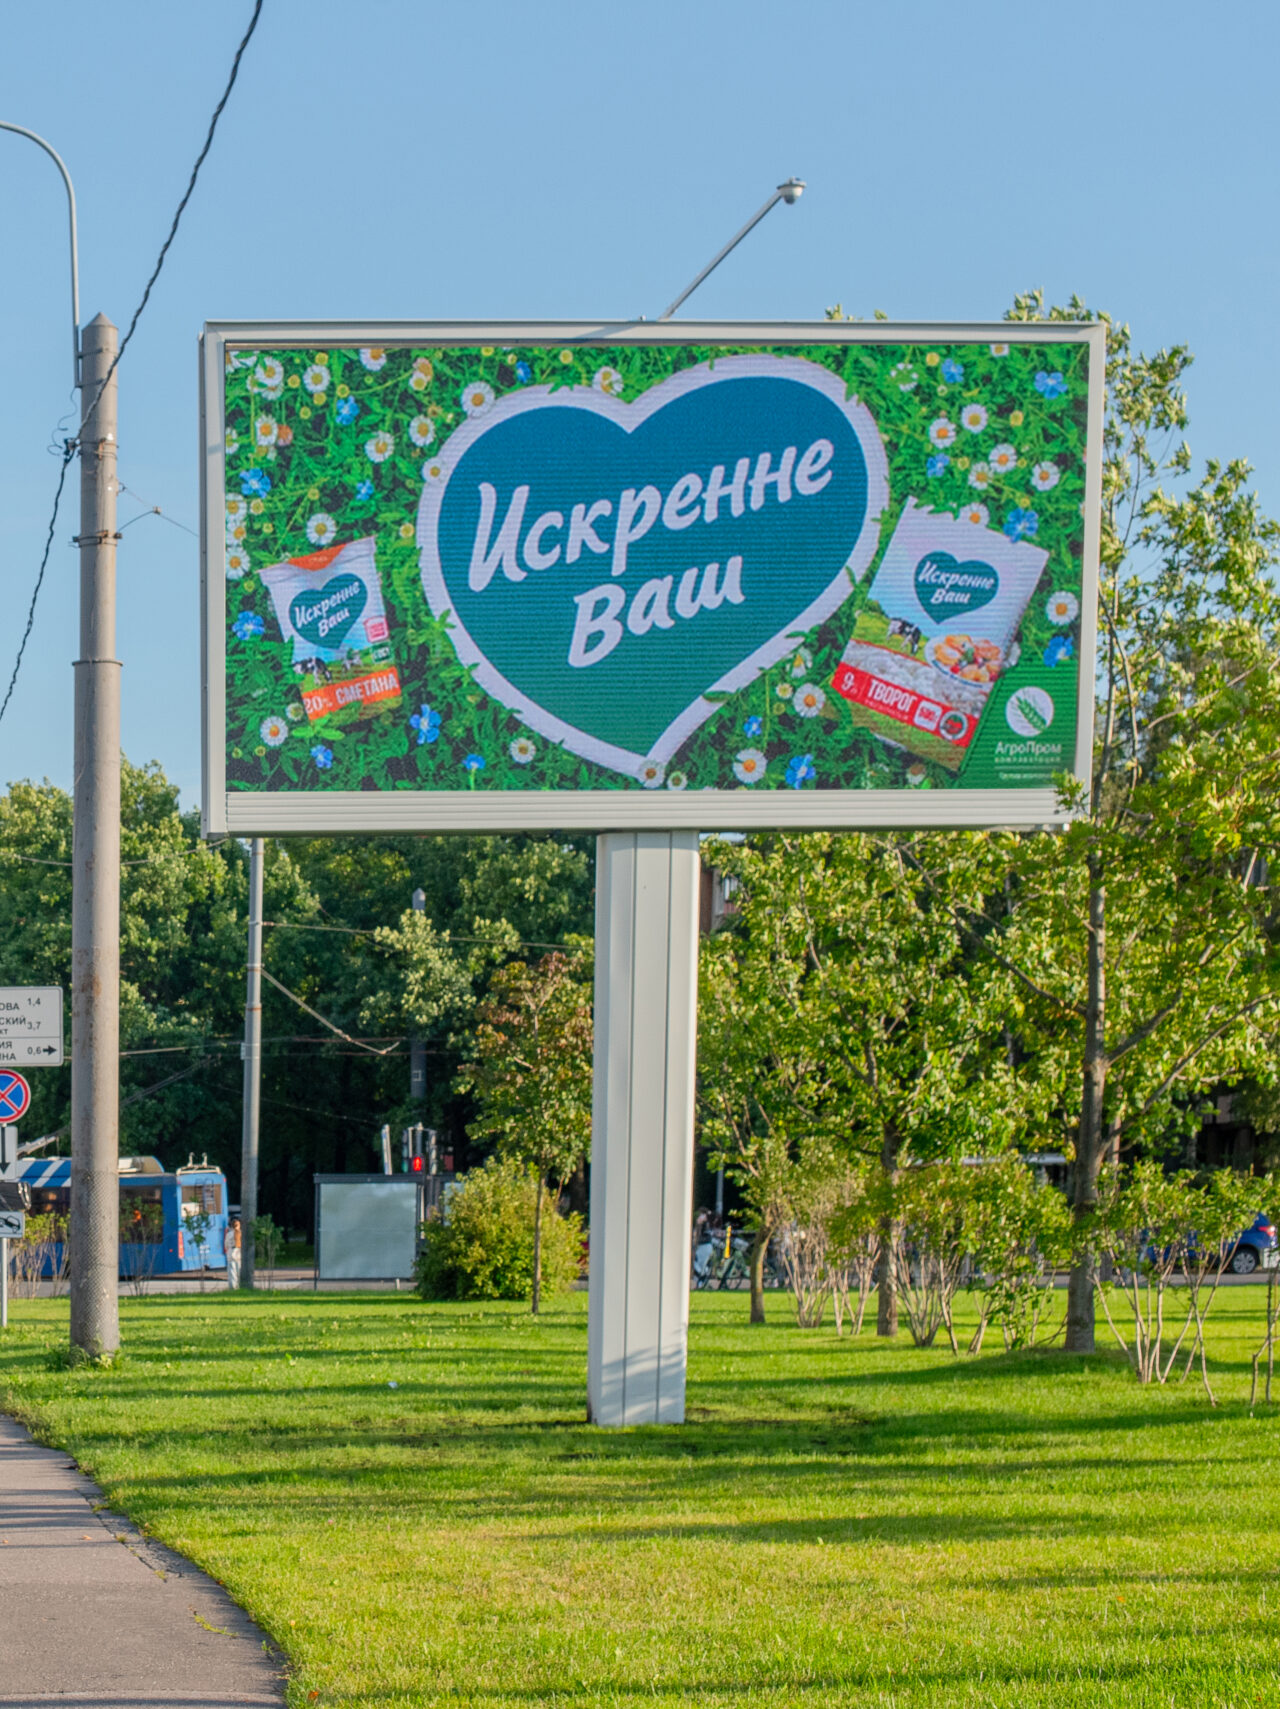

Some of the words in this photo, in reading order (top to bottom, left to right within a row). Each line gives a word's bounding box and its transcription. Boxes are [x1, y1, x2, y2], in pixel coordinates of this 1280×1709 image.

[468, 438, 834, 593] Искренне
[917, 561, 995, 590] Искренне
[294, 581, 360, 630] Искренне
[569, 554, 746, 668] Ваш
[930, 588, 971, 605] Ваш
[318, 607, 350, 638] Ваш
[335, 671, 398, 705] СМЕТАНА
[867, 679, 918, 713] ТВОРОГ
[995, 741, 1062, 756] АгроПром
[27, 998, 41, 1007] 1,4
[27, 1046, 42, 1055] 0,6
